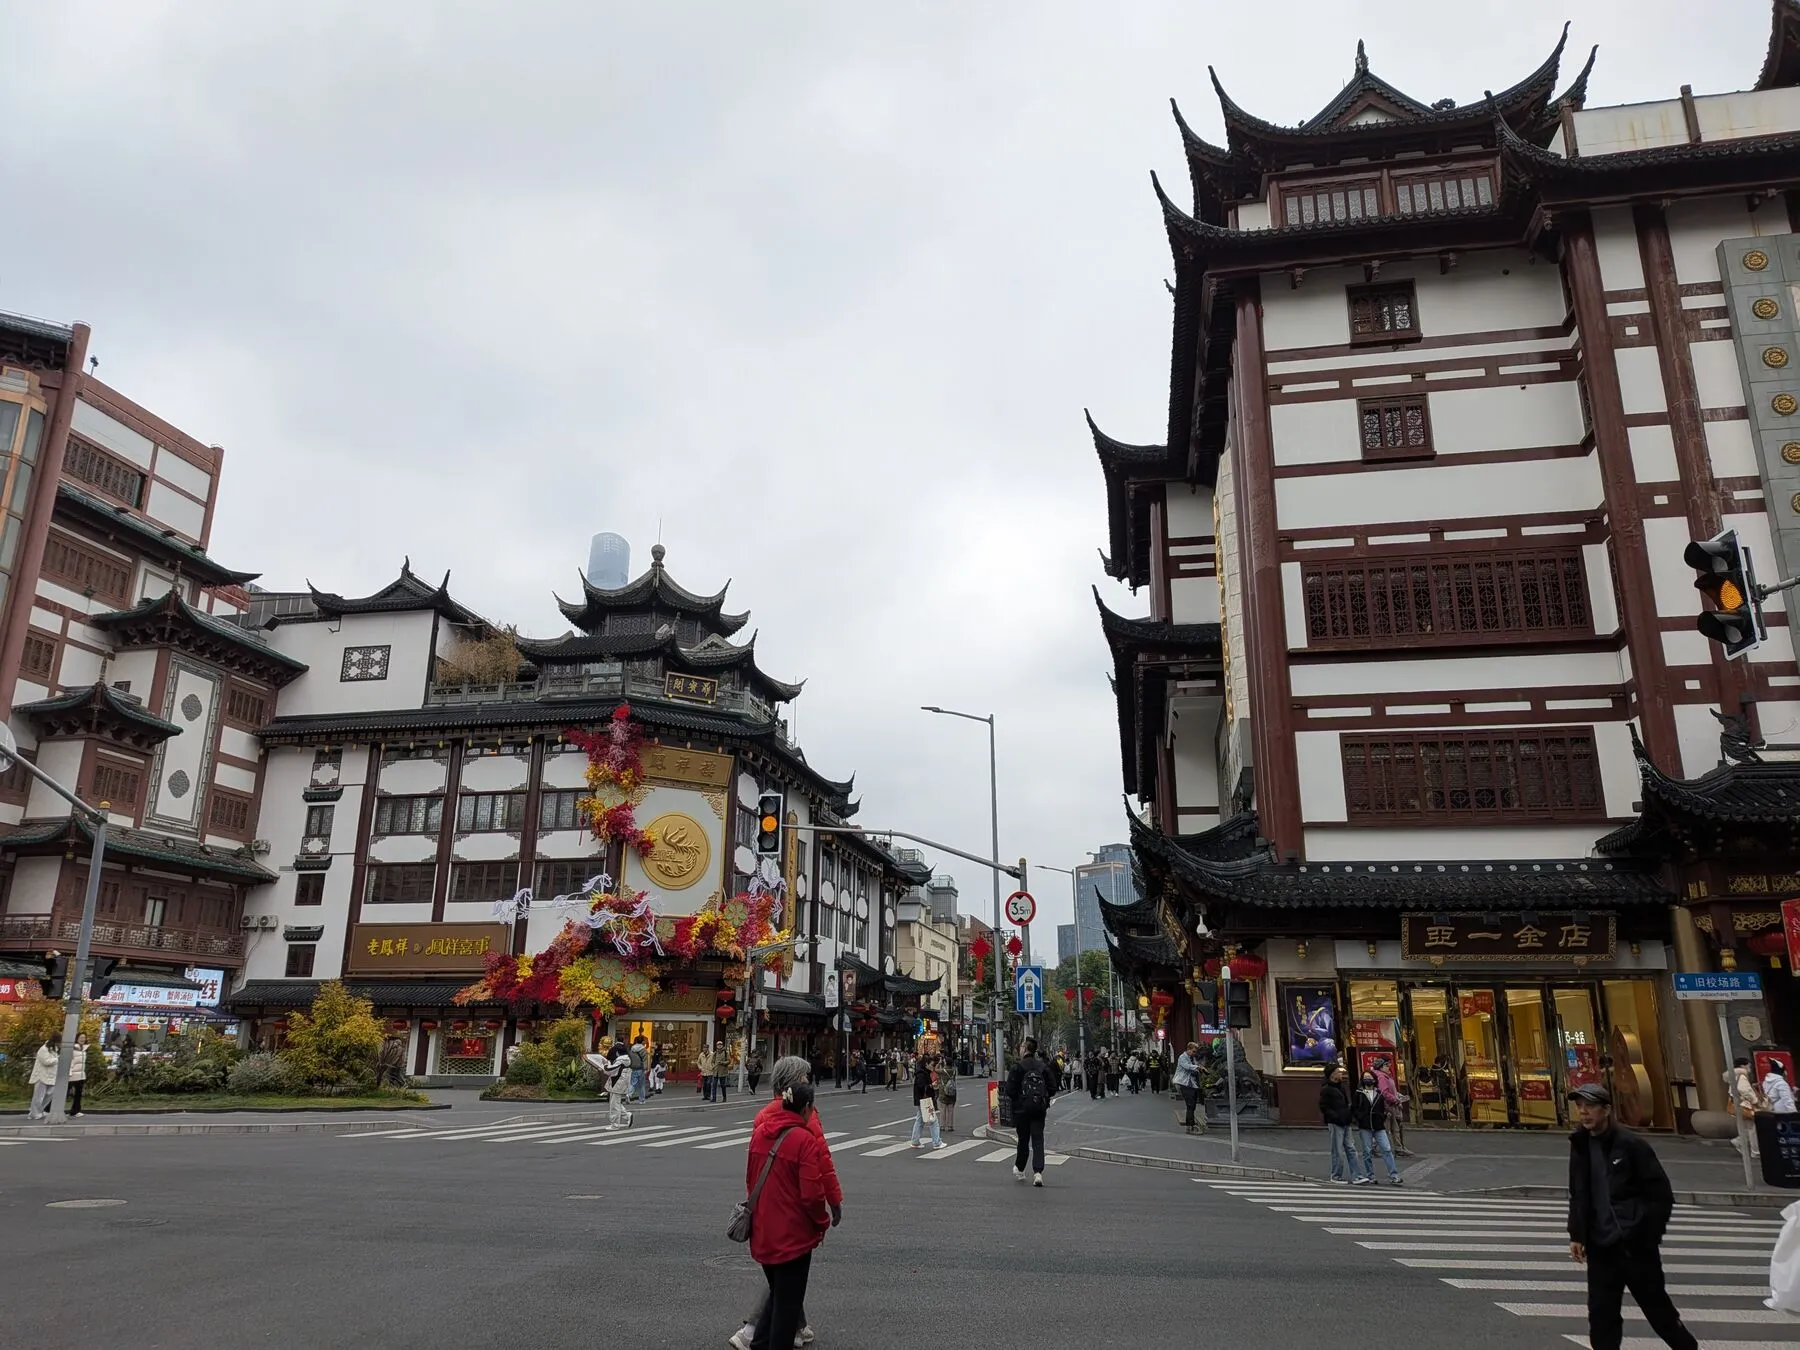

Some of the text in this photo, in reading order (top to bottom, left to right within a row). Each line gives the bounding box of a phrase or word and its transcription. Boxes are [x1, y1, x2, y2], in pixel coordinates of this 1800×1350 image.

[1011, 902, 1031, 916] 3.5m
[1425, 924, 1592, 948] 亞一金店
[367, 938, 408, 957] 老鳳祥
[1695, 977, 1741, 988] 旧校场路
[139, 989, 160, 999] 大肉串
